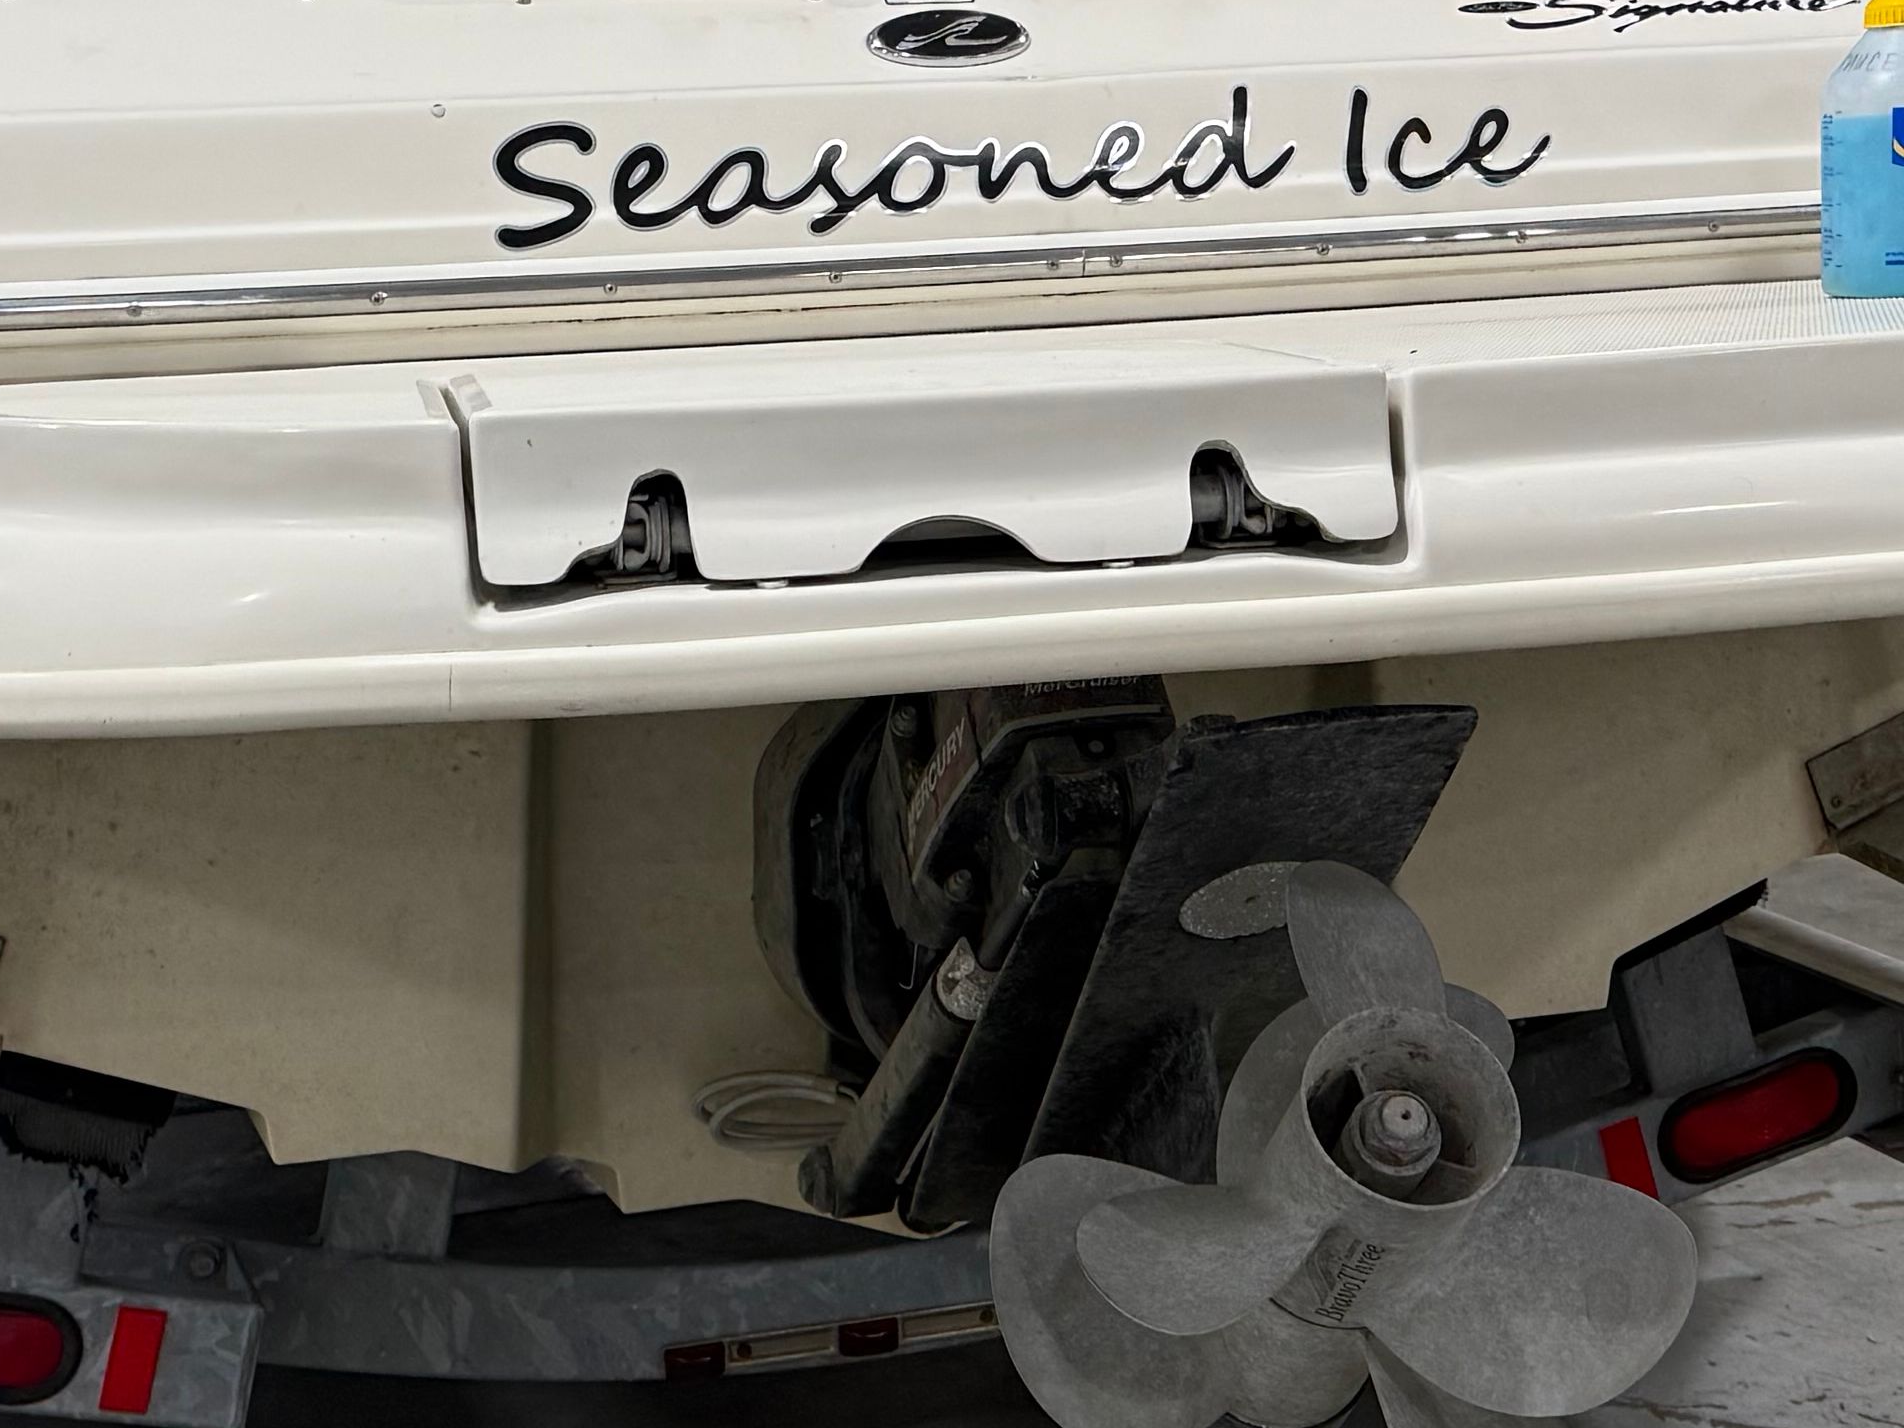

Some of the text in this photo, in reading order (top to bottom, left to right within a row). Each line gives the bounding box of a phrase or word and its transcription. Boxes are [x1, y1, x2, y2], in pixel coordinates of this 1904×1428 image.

[494, 83, 1553, 250] Seasoned Ice
[907, 716, 966, 857] MERCURY
